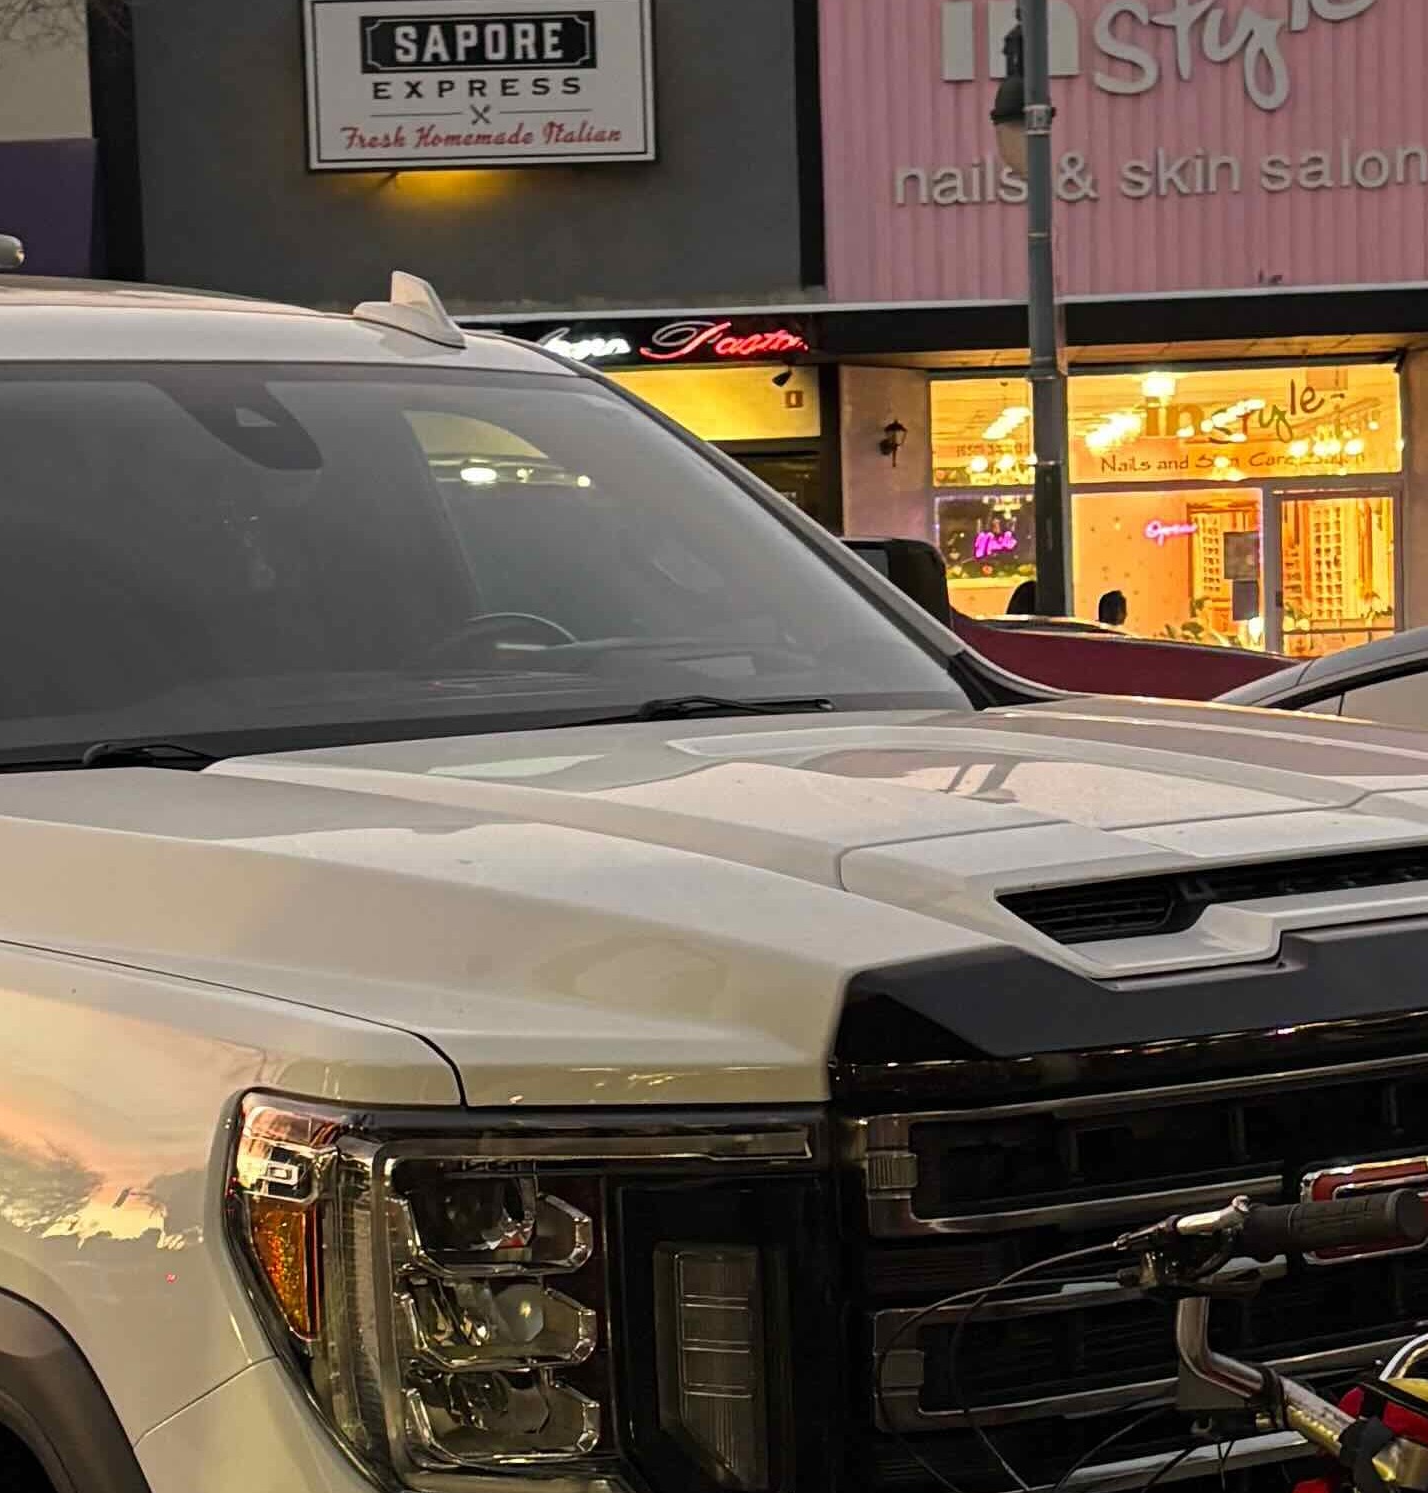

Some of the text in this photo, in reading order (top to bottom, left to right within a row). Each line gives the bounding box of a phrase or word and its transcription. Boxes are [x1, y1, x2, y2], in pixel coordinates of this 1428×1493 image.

[393, 21, 564, 63] SAPORE
[372, 76, 582, 100] EXPRESS
[340, 119, 622, 150] Fresh Homemade Italian
[894, 156, 1030, 206] nails
[1054, 151, 1099, 202] &
[1120, 147, 1242, 199] skin
[1100, 457, 1152, 473] Nails
[1156, 453, 1190, 470] and
